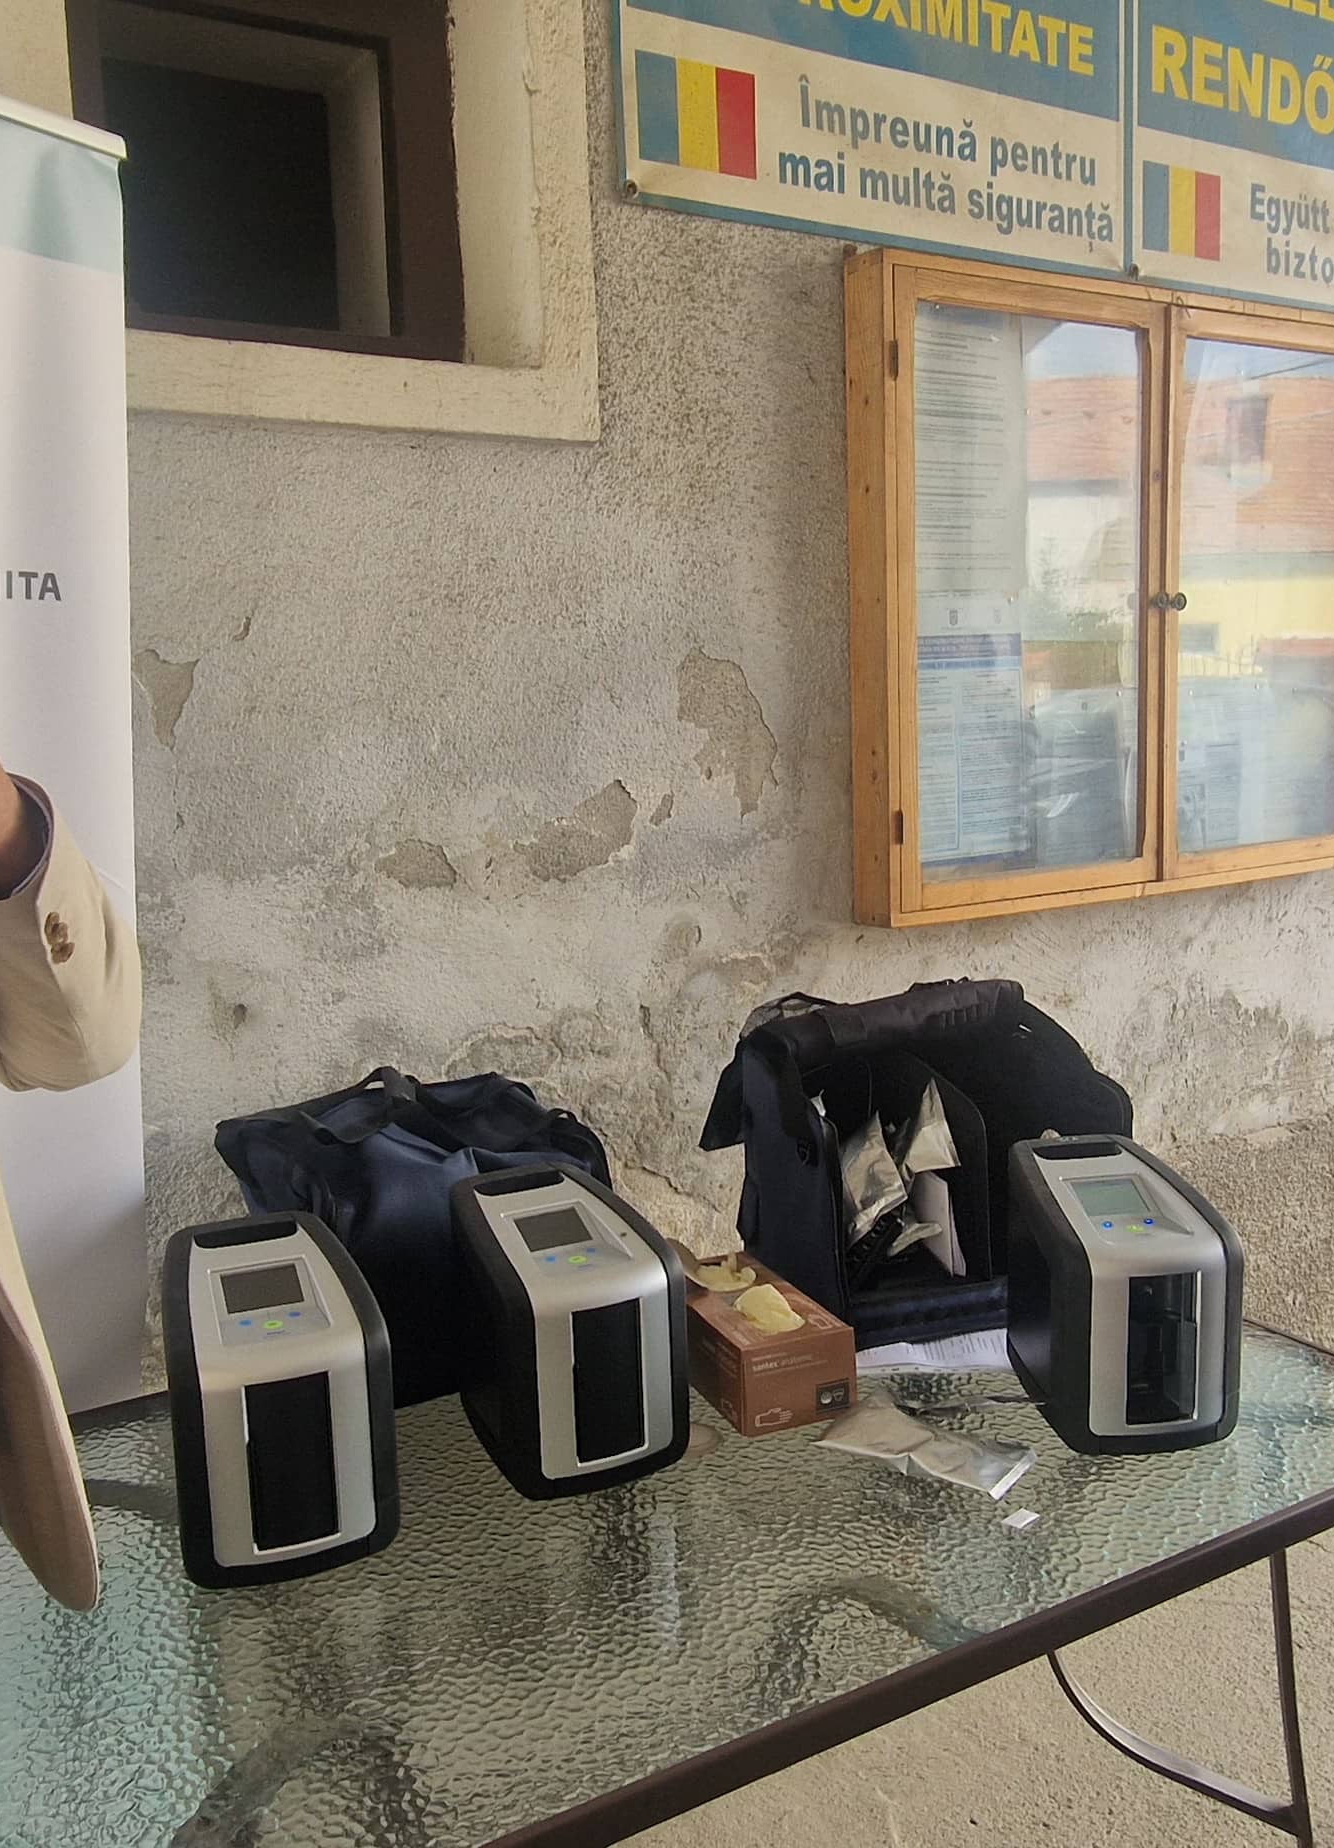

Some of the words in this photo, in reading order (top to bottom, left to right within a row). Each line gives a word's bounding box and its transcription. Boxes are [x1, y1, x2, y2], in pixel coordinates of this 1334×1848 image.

[795, 0, 1095, 77] XIMITATE
[798, 73, 977, 162] Împreună
[990, 135, 1096, 187] pentru
[778, 151, 845, 195] mai
[859, 166, 956, 215] multă
[968, 181, 1114, 253] siguranță
[1250, 182, 1329, 236] Együtt
